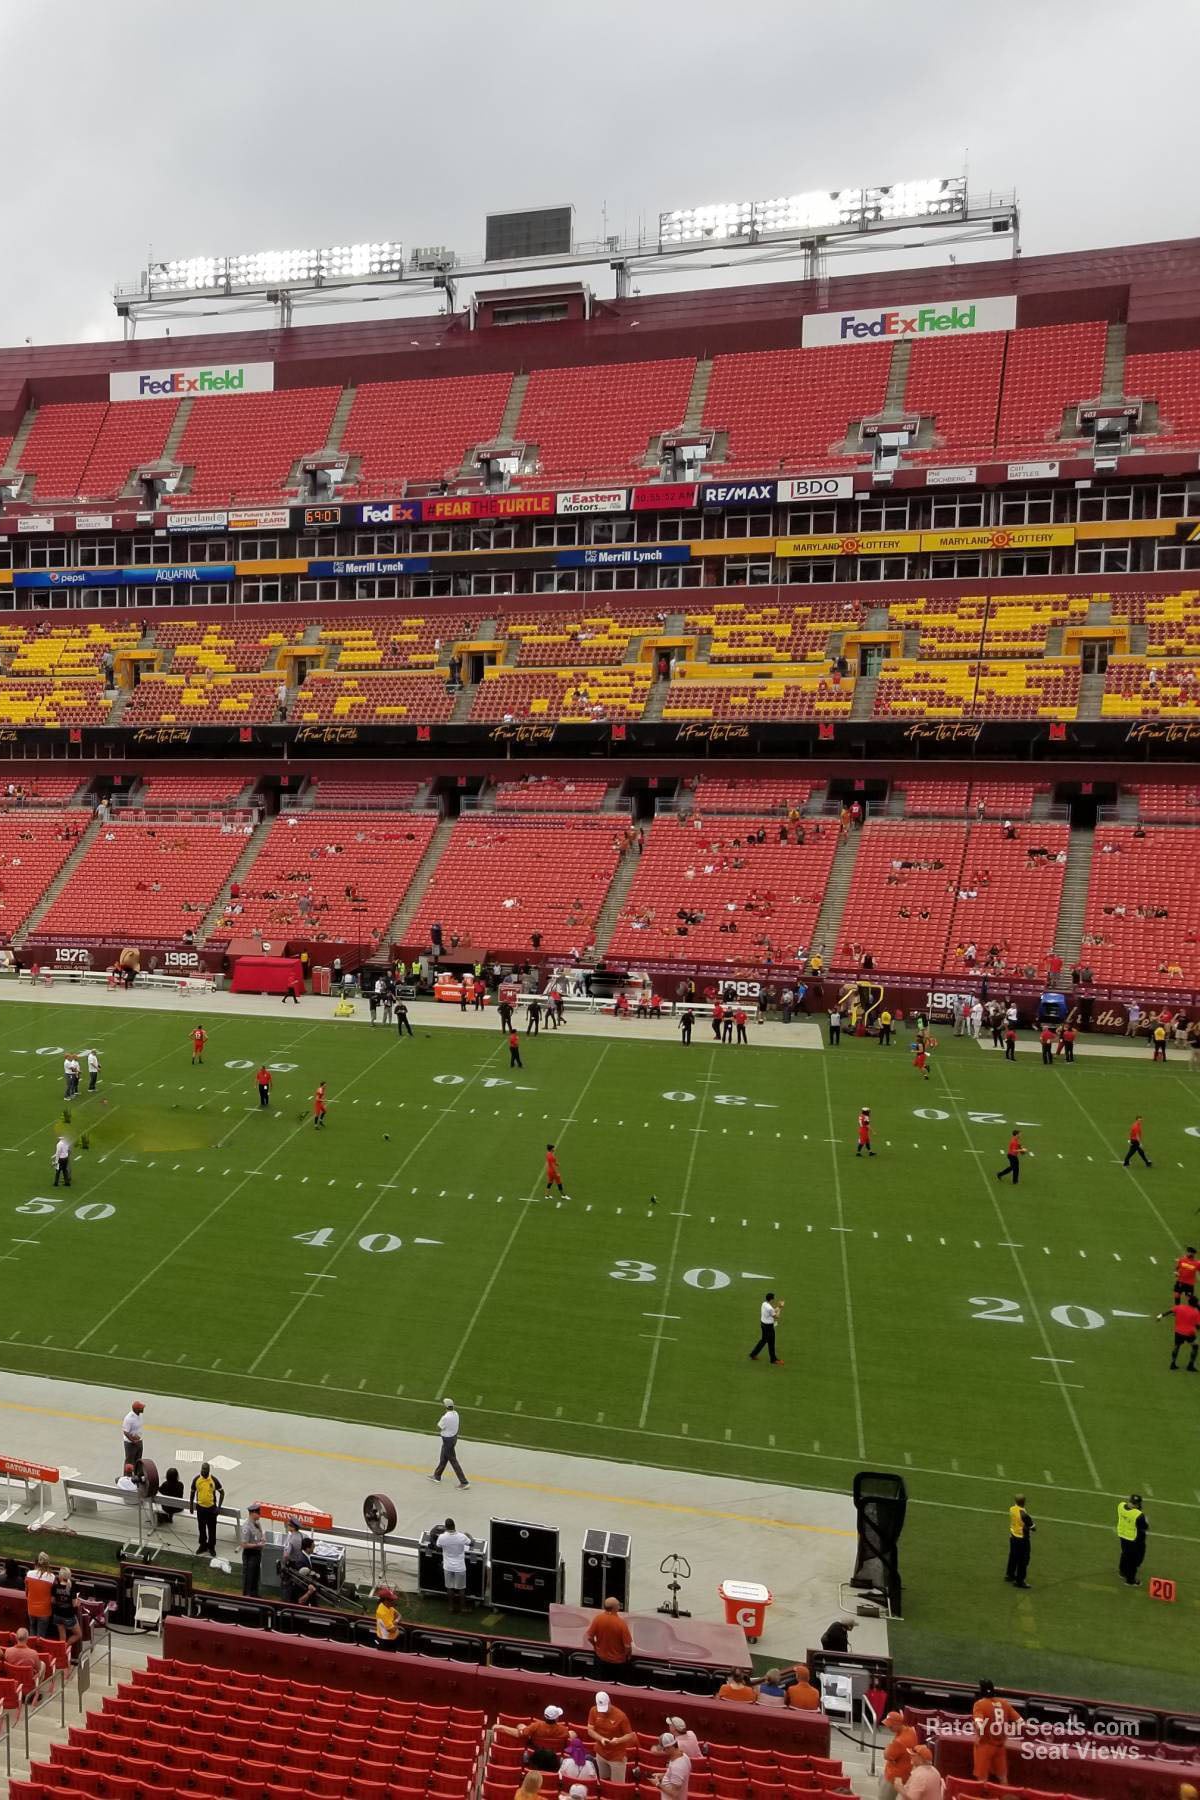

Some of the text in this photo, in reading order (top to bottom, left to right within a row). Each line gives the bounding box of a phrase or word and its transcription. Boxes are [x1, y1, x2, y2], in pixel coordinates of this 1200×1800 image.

[840, 305, 976, 339] FedExField
[140, 369, 244, 395] FedExField
[705, 486, 771, 501] RE/MAX
[796, 480, 839, 495] BDO
[572, 493, 621, 503] Eastern
[362, 504, 416, 523] FedEx
[793, 540, 900, 551] MARYLAND LOTTERY
[939, 534, 1053, 546] MARYLAND LOTTERY
[598, 550, 662, 563] Merrill Lynch
[345, 561, 403, 573] Merrill Lynch
[61, 573, 86, 584] pepsi
[155, 568, 198, 581] AQUAFINA
[55, 948, 89, 962] 1972
[164, 952, 198, 966] 1982
[5, 1462, 41, 1477] GATORADE
[1152, 1580, 1173, 1599] 20
[735, 1607, 756, 1627] G
